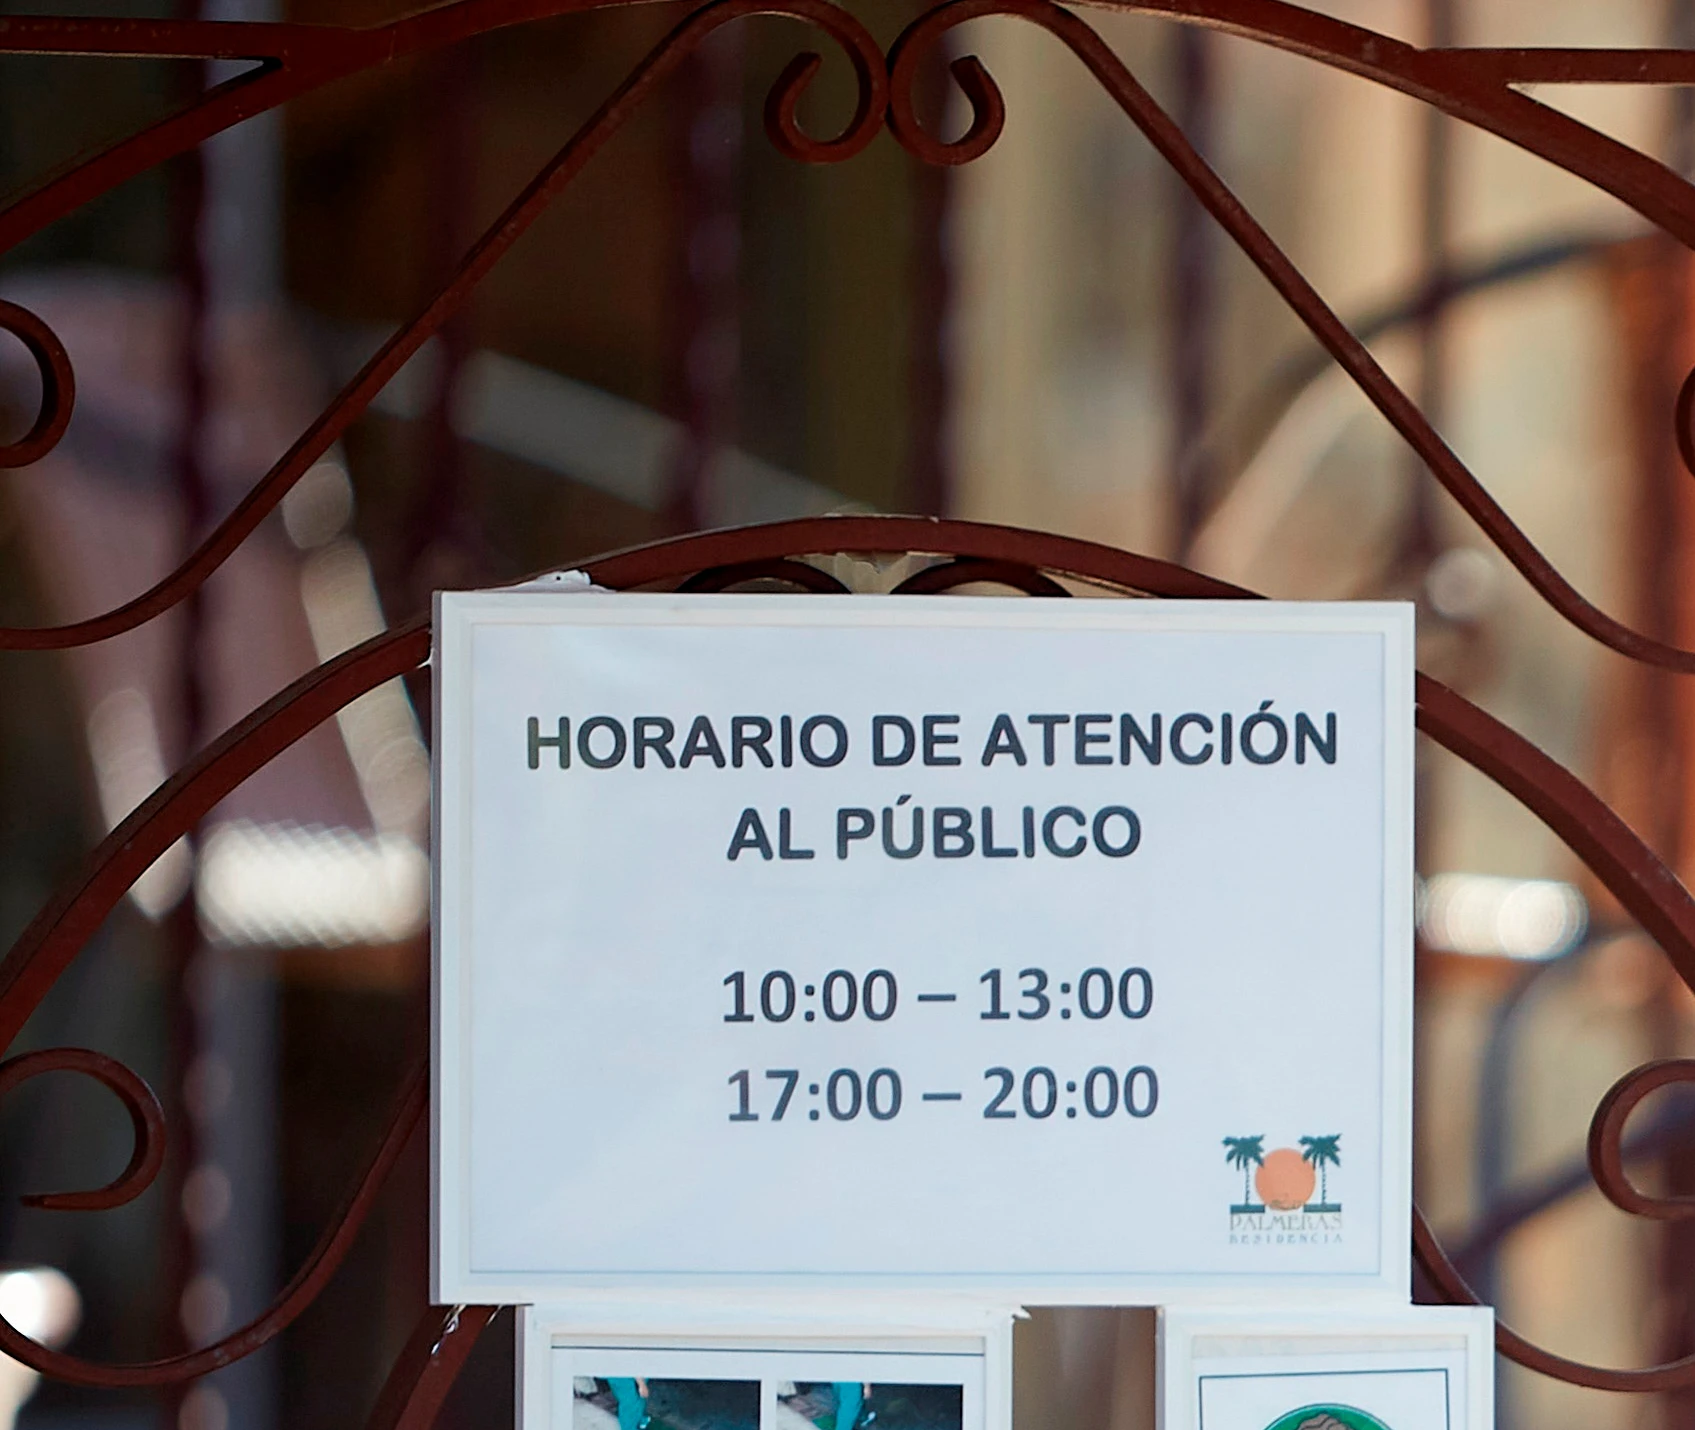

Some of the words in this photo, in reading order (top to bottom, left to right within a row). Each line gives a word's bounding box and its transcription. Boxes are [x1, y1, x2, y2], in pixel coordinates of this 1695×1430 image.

[528, 715, 848, 769] HORARIO
[872, 715, 961, 766] DE
[981, 700, 1336, 767] ATENCIÓN
[727, 807, 815, 861] AL
[837, 794, 1141, 860] PÚBLICO
[724, 969, 897, 1023] 10:00
[980, 967, 1153, 1020] 13:00
[729, 1068, 902, 1121] 17:00
[984, 1066, 1158, 1119] 20:00
[1230, 1213, 1342, 1232] PALMERAS
